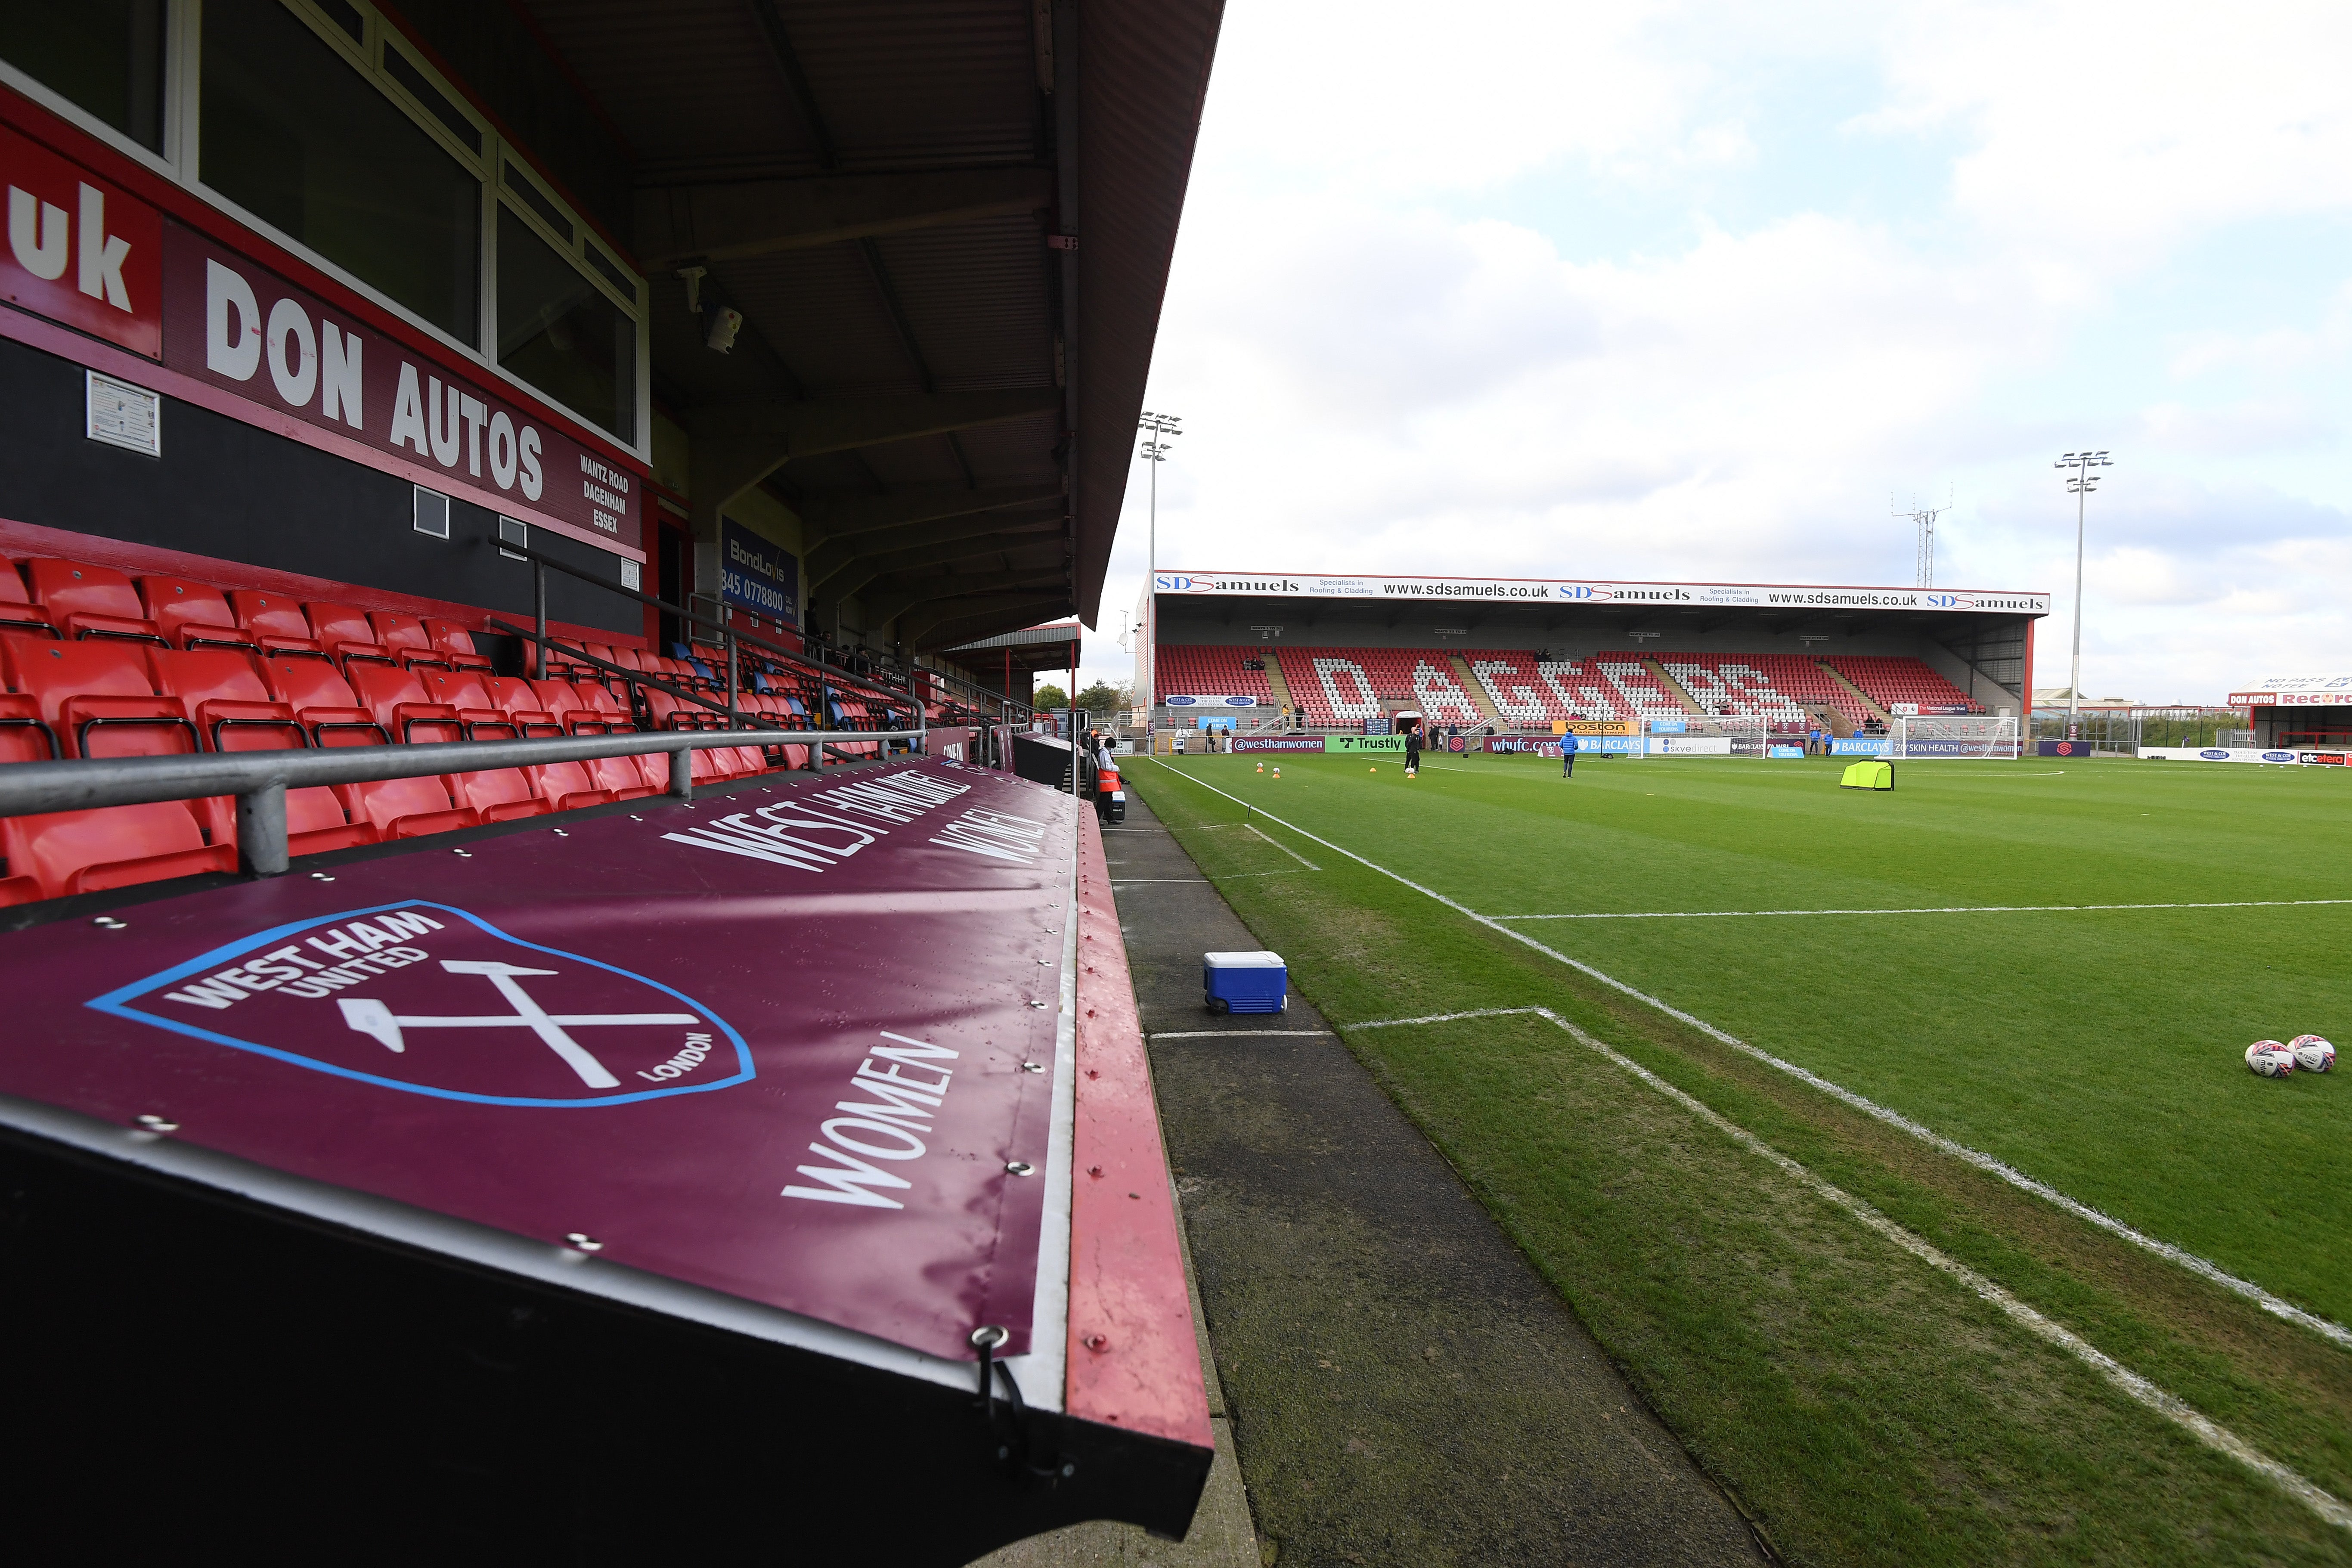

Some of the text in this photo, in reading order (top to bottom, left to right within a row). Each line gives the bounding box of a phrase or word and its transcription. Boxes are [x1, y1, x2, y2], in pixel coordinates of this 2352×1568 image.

[8, 181, 133, 314] uk
[207, 258, 363, 431] DON
[390, 361, 542, 501] AUTOS
[580, 454, 629, 493] WANTZ ROAD
[584, 480, 626, 515] DAGENHAM
[593, 508, 618, 533] ESSEX
[744, 579, 783, 611] 0778800
[1383, 583, 1549, 598] www.sdsamuels.co.uk
[1769, 592, 1917, 606] www.sdsamuels.co.uk
[2230, 695, 2275, 704] DON AUTOS
[1565, 722, 1625, 731] boston
[1234, 738, 1323, 751] @westhamwomen
[1357, 737, 1401, 751] Trustly
[1590, 740, 1641, 750] BARCLAYS
[1670, 744, 1717, 753] skyedirect
[1842, 742, 1889, 752] BARCLAYS
[1929, 744, 1958, 752] HEALTH
[1960, 744, 2022, 753] @westhmwomn
[2302, 753, 2343, 763] etcetera
[660, 801, 890, 873] WEST
[928, 805, 1047, 864] WOMEN
[164, 911, 445, 1010] WEST HAM
[277, 946, 429, 999] UNITED
[636, 1032, 712, 1082] LONDON
[2298, 1051, 2318, 1063] mitre
[781, 1031, 959, 1210] WOMEN
